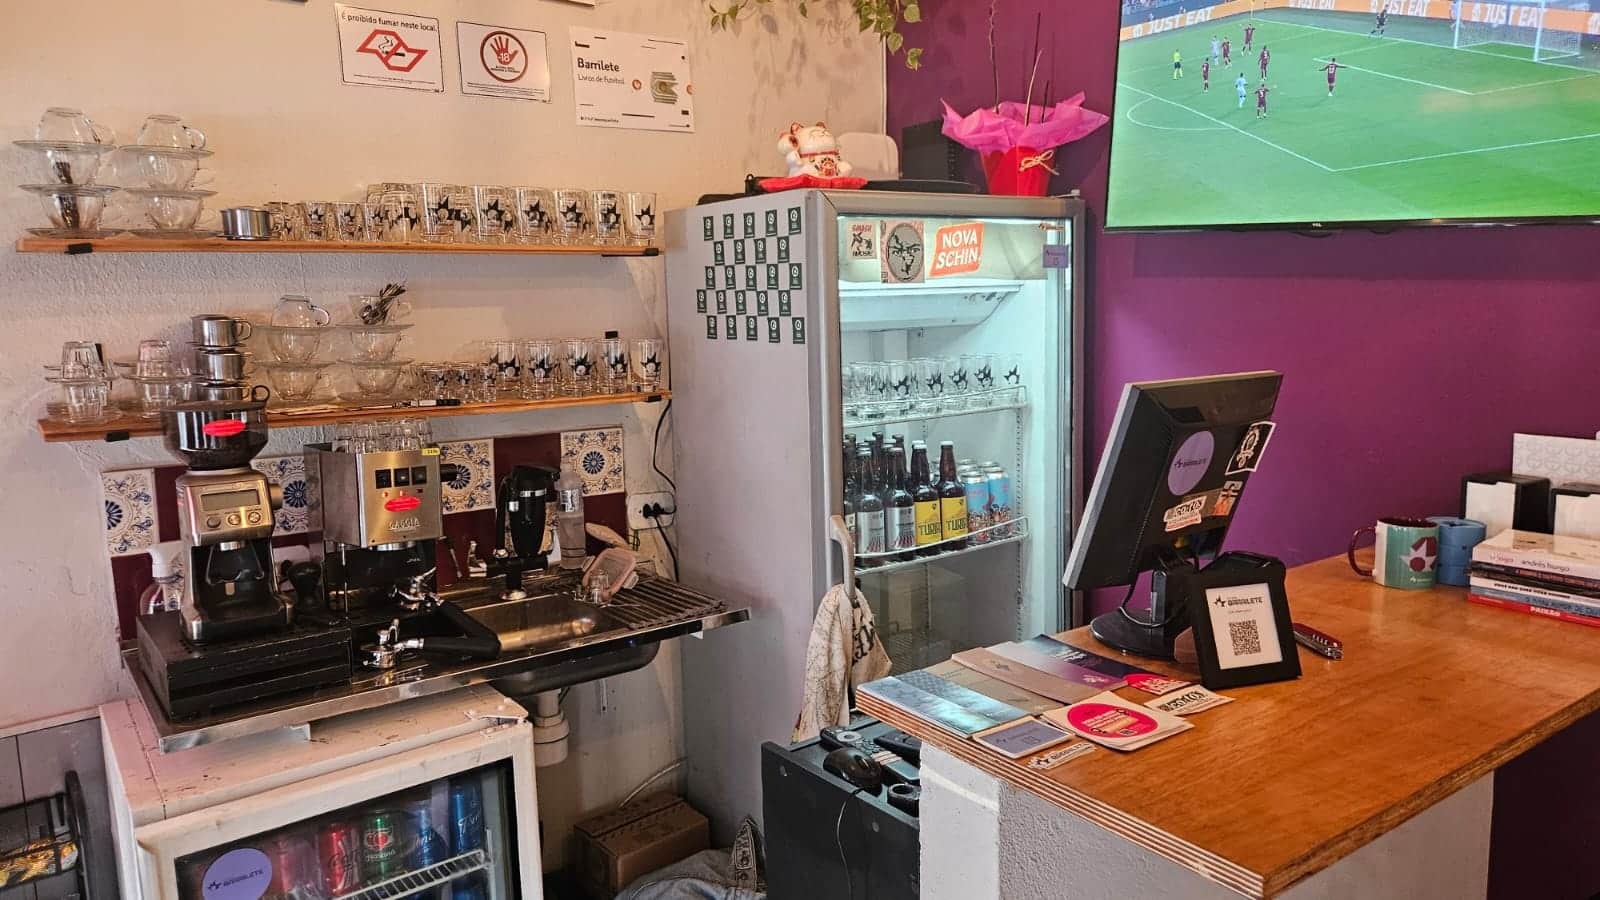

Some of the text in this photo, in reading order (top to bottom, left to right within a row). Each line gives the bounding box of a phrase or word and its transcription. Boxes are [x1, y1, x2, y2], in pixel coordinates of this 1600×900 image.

[347, 14, 377, 24] proibido
[378, 17, 399, 27] fumar
[400, 21, 419, 30] neste
[1149, 7, 1215, 35] JUST EAT
[577, 57, 620, 73] Barrilete
[942, 229, 978, 249] NOVA
